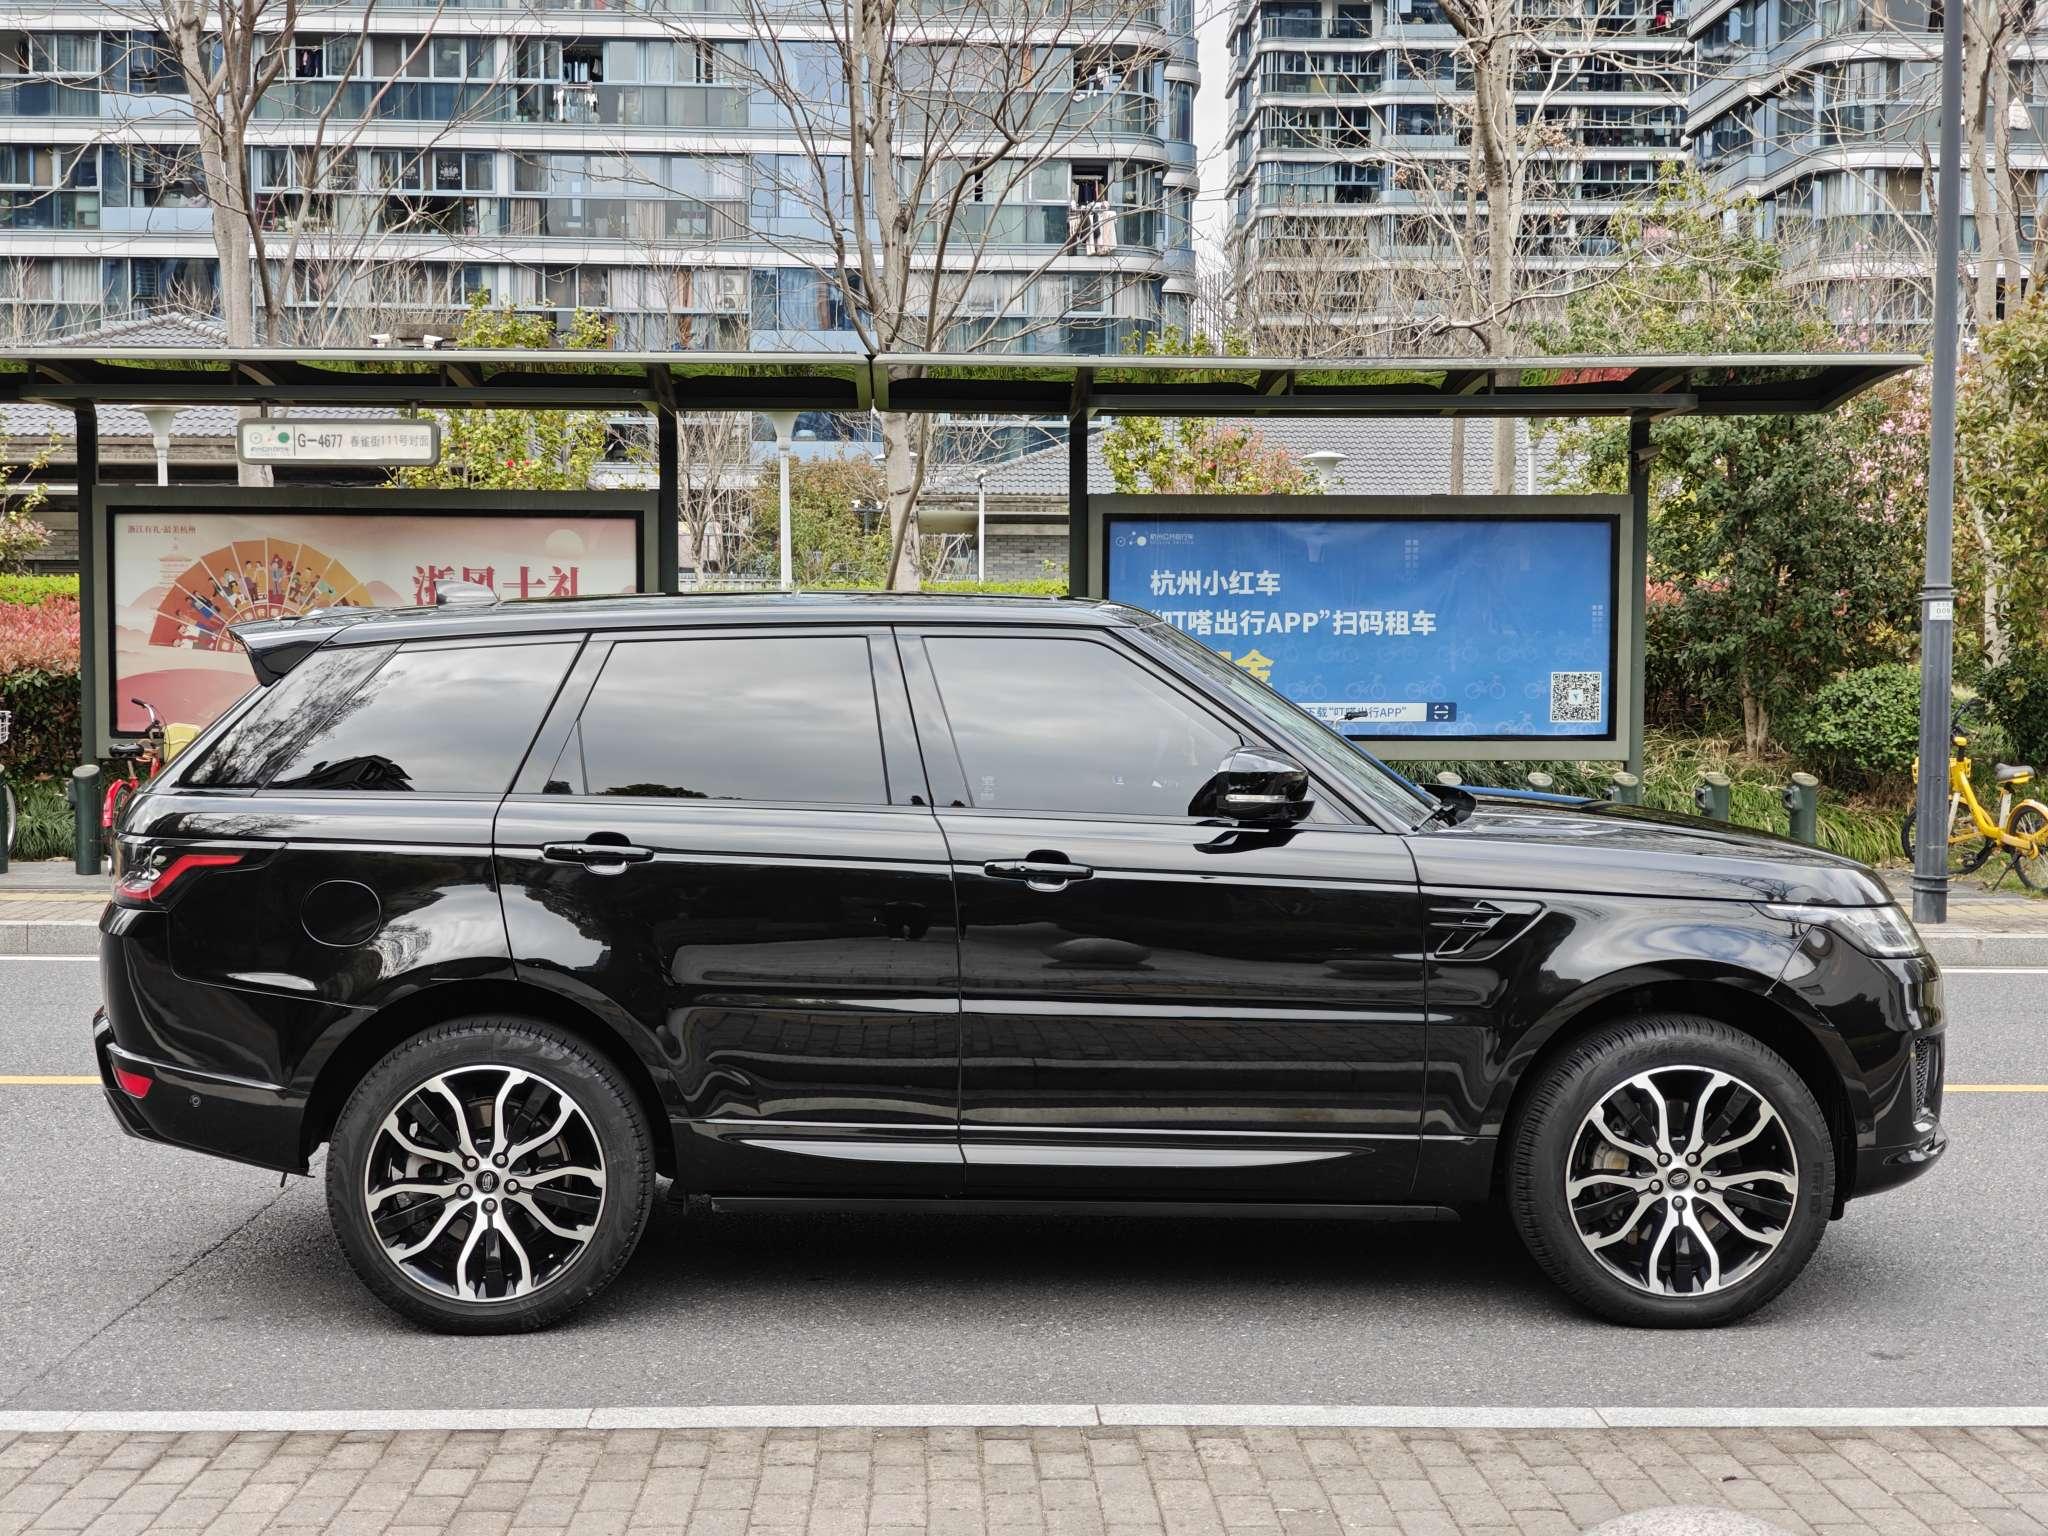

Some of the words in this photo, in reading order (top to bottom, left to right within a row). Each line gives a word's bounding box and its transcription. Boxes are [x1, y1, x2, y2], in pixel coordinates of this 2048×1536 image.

[1150, 569, 1281, 596] 杭州小红车
